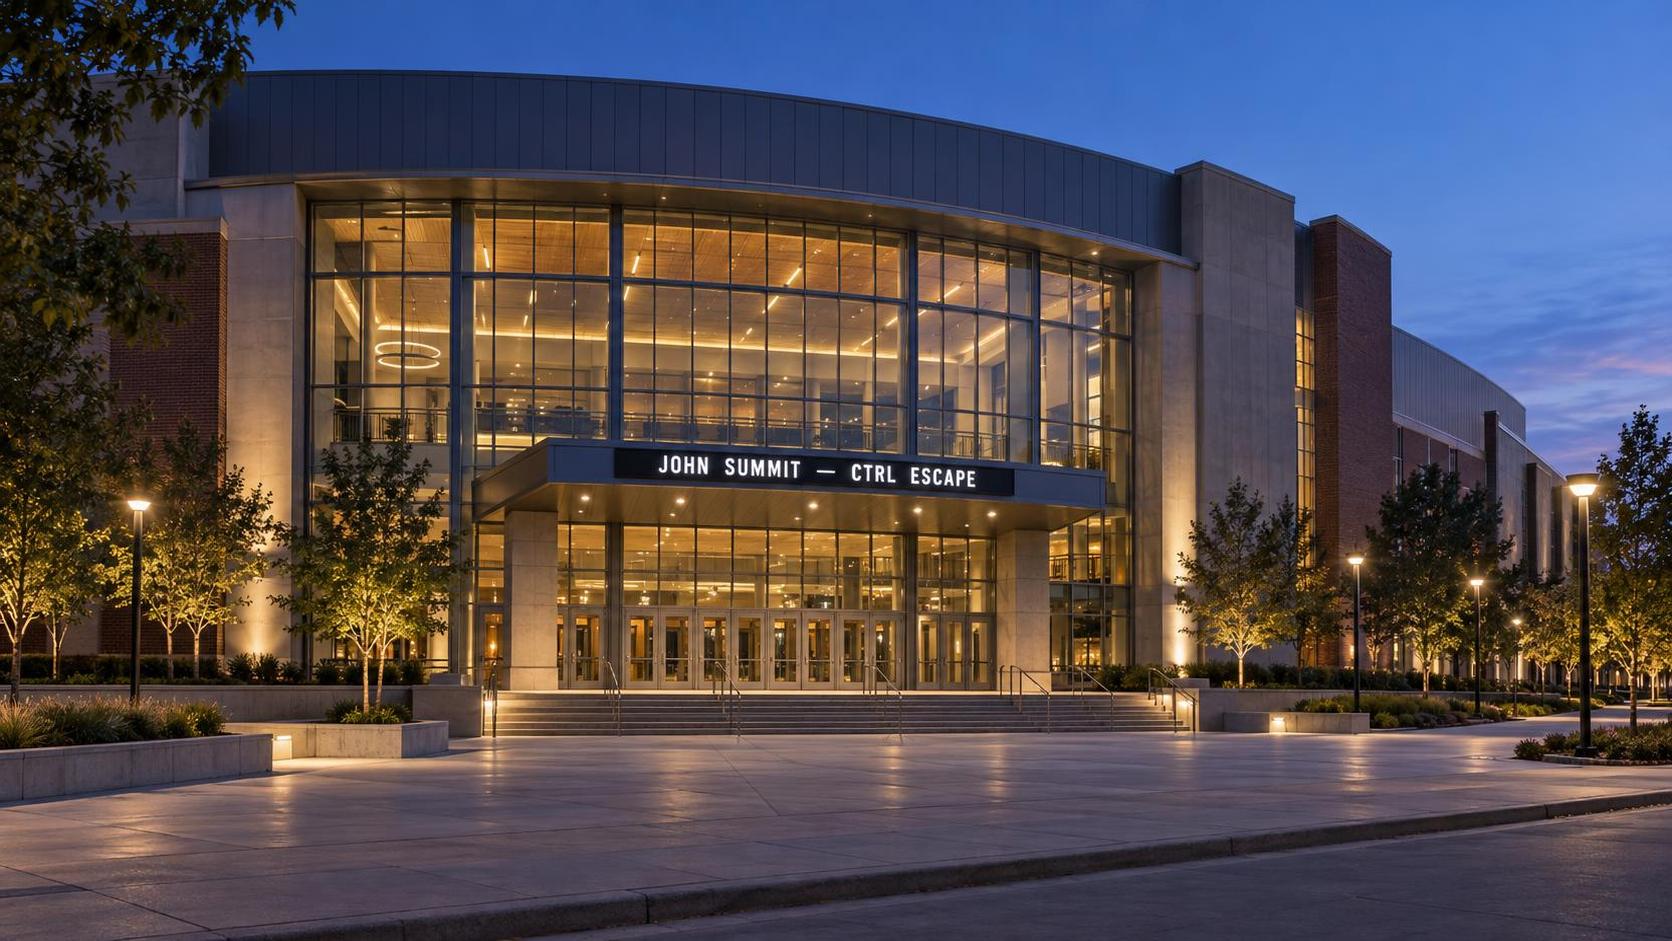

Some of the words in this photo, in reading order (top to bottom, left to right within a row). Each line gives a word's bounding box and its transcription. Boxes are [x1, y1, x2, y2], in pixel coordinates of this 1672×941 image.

[658, 455, 709, 475] JOHN
[725, 458, 801, 479] SUMMIT
[851, 463, 897, 484] CTRL
[910, 467, 976, 488] ESCAPE
